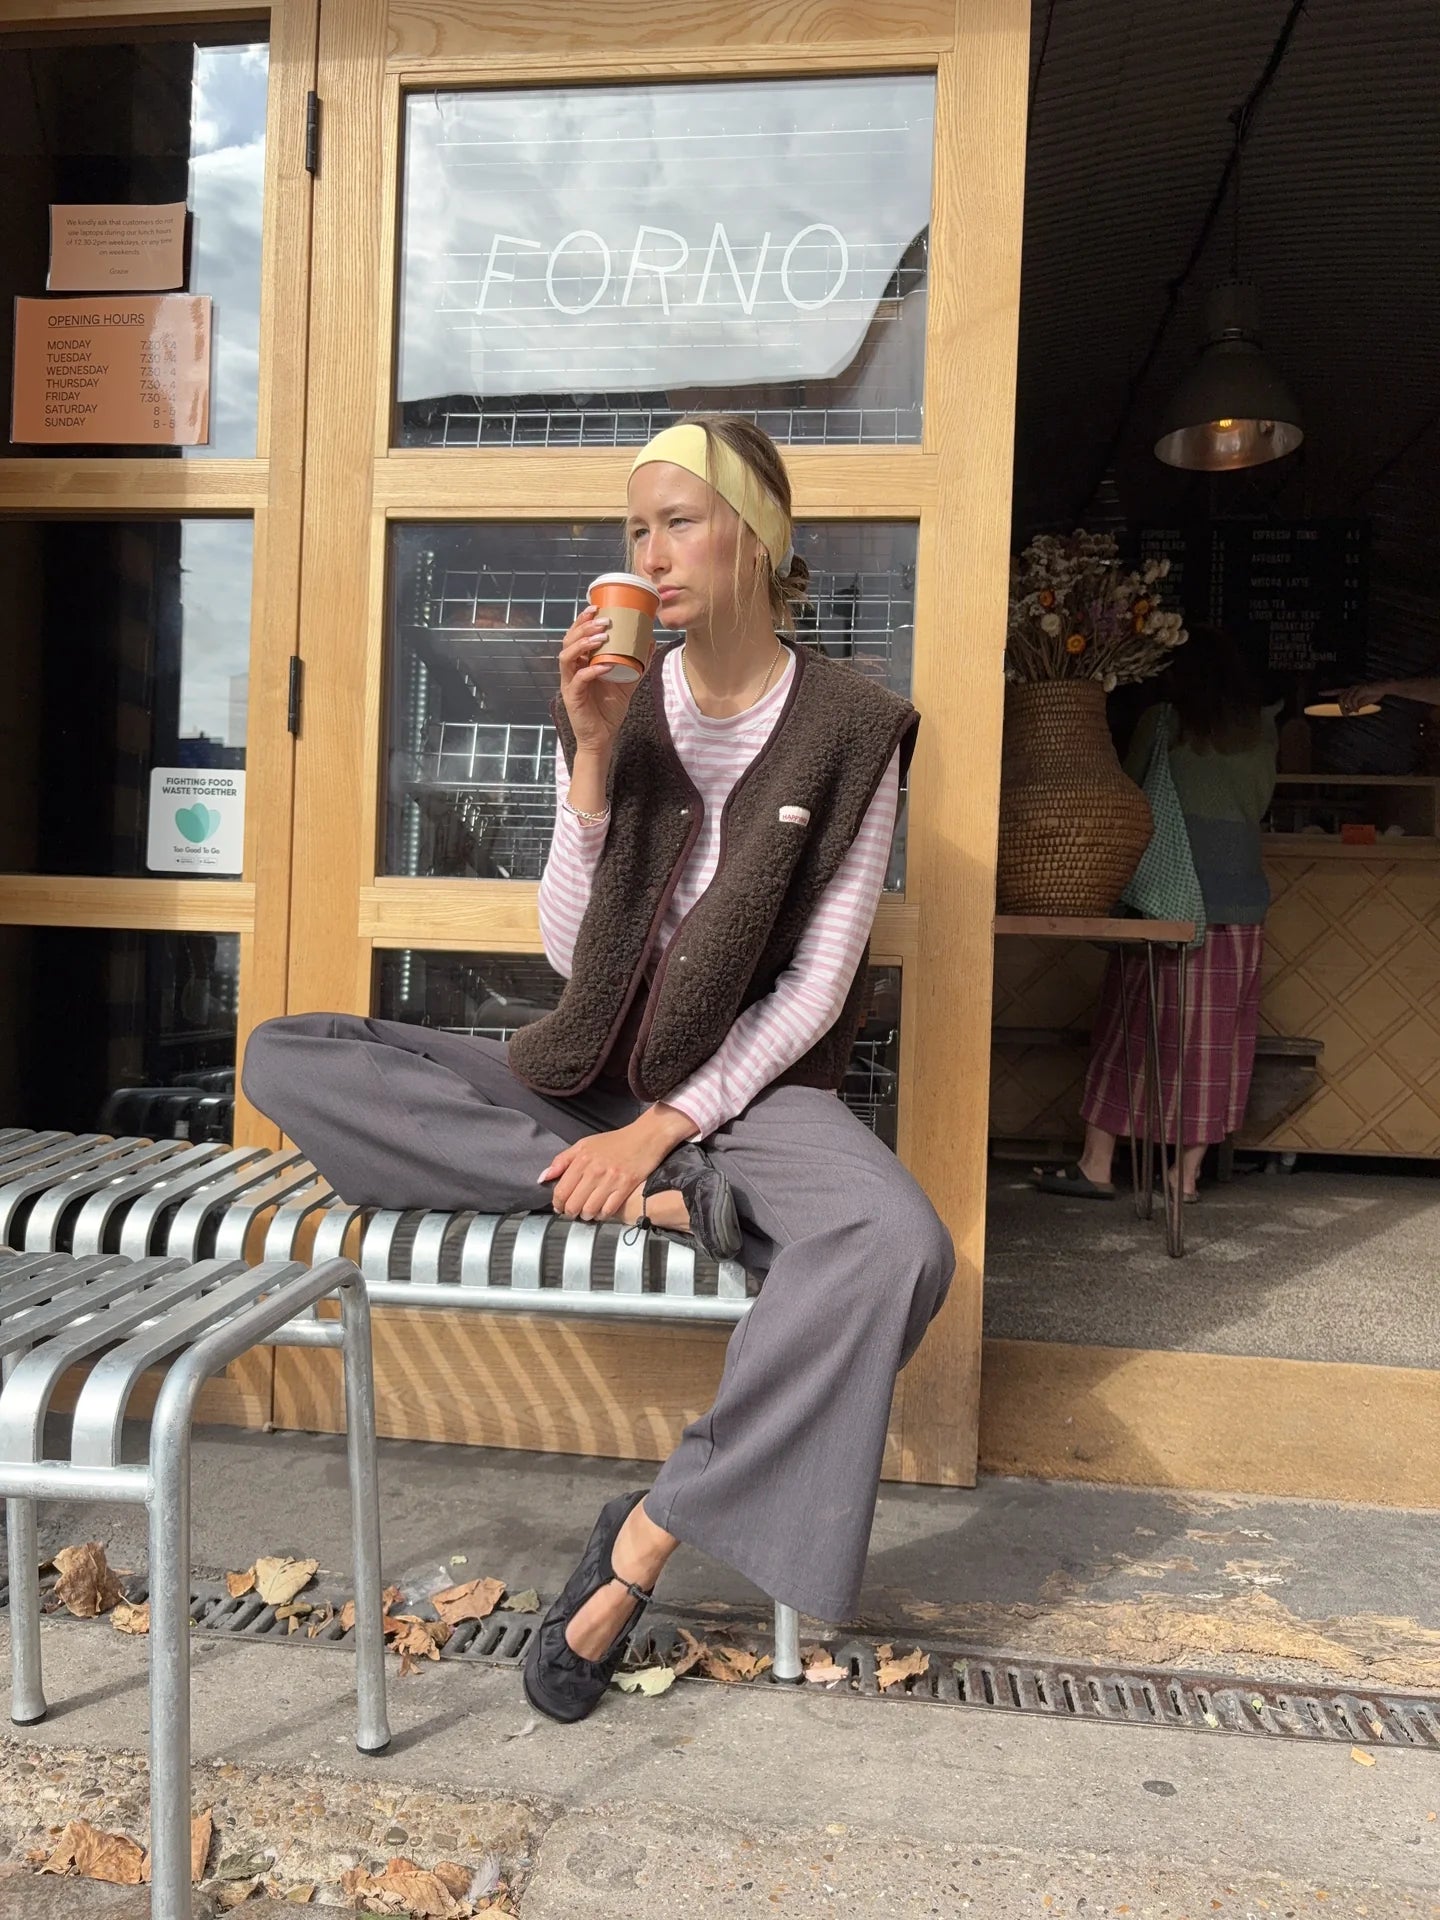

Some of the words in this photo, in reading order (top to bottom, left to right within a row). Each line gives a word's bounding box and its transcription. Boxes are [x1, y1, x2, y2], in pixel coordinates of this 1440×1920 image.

[477, 222, 849, 315] FORNO
[48, 313, 100, 327] OPENING
[103, 313, 145, 325] HOURS
[47, 339, 91, 350] MONDAY
[47, 352, 92, 363] TUESDAY
[46, 365, 109, 376] WEDNESDAY
[46, 378, 100, 389] THURSDAY
[45, 391, 81, 402] FRIDAY
[45, 404, 98, 414] SATURDAY
[153, 406, 160, 416] 8
[44, 417, 86, 428] SUNDAY
[153, 419, 160, 429] 8
[169, 419, 175, 429] 5
[166, 777, 206, 786] FIGHTING
[208, 778, 234, 787] FOOD
[162, 786, 192, 795] WASTE
[193, 787, 237, 796] TOGETHER
[173, 845, 184, 853] Too
[184, 846, 202, 854] Good
[203, 846, 210, 854] To
[211, 847, 220, 855] Go
